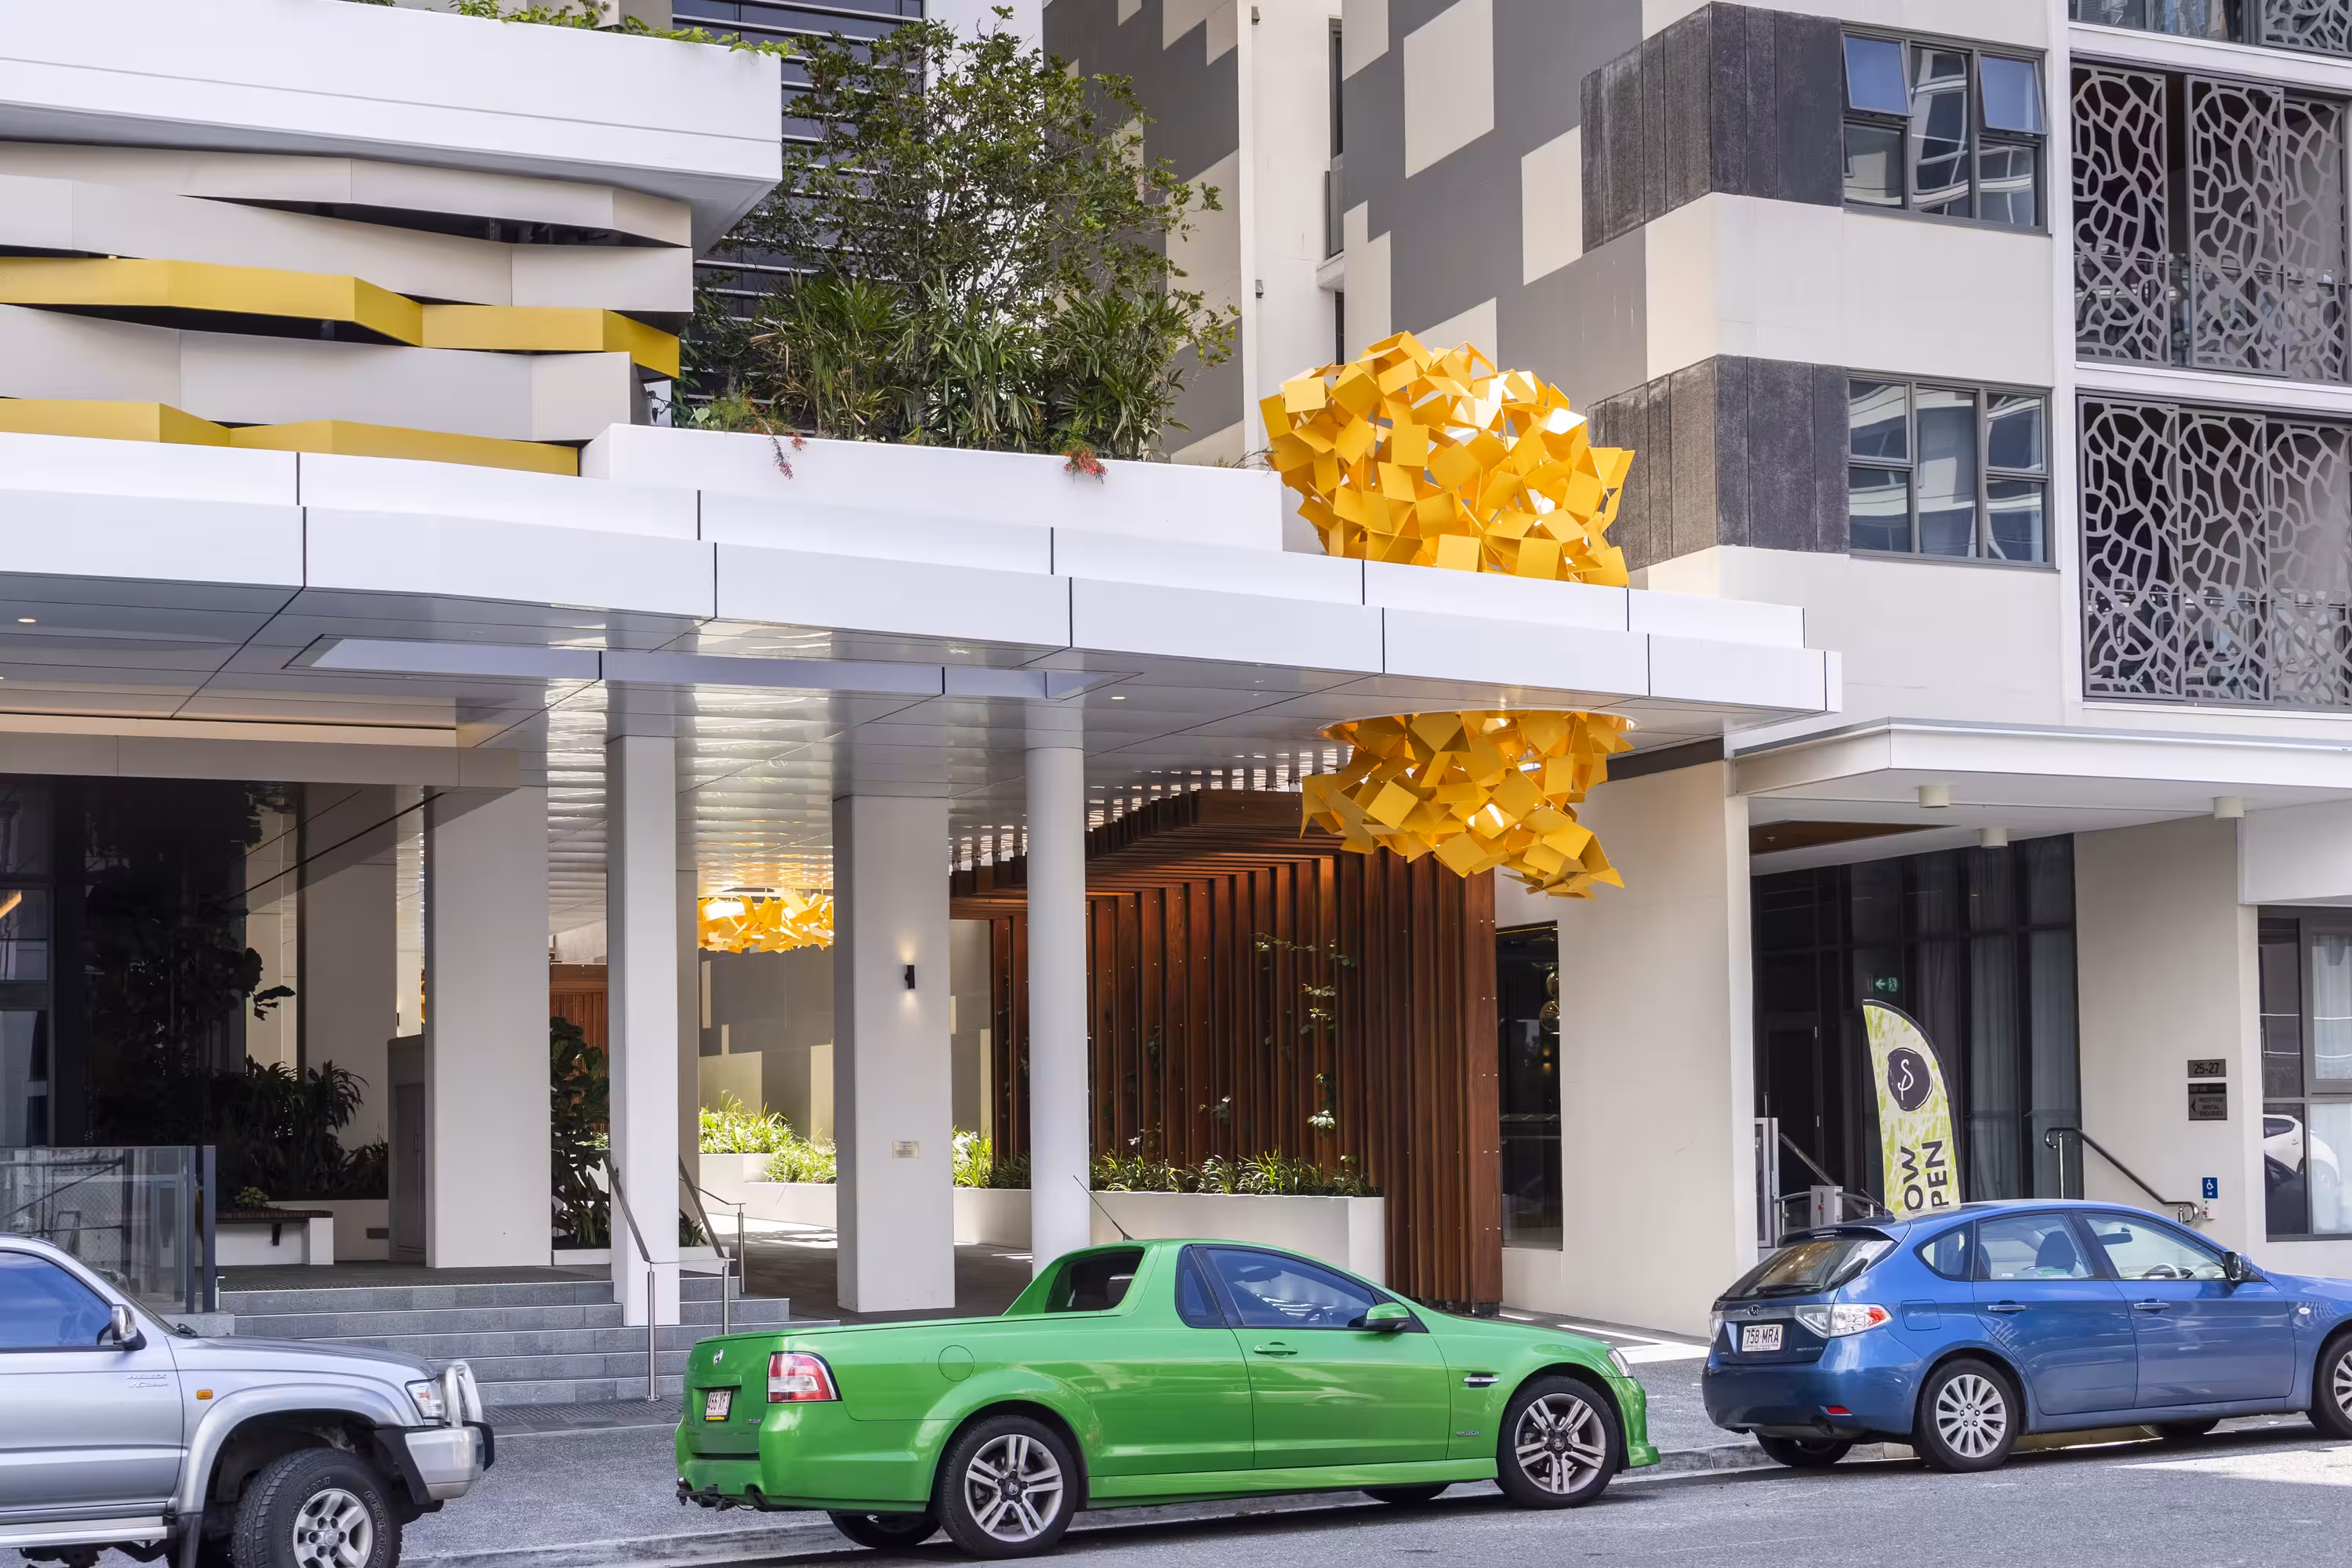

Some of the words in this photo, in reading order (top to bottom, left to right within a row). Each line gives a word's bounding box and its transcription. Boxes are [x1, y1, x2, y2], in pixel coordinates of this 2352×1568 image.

[2194, 1062, 2220, 1075] 25-27
[1900, 1145, 1924, 1210] OW
[1922, 1140, 1950, 1207] PEN
